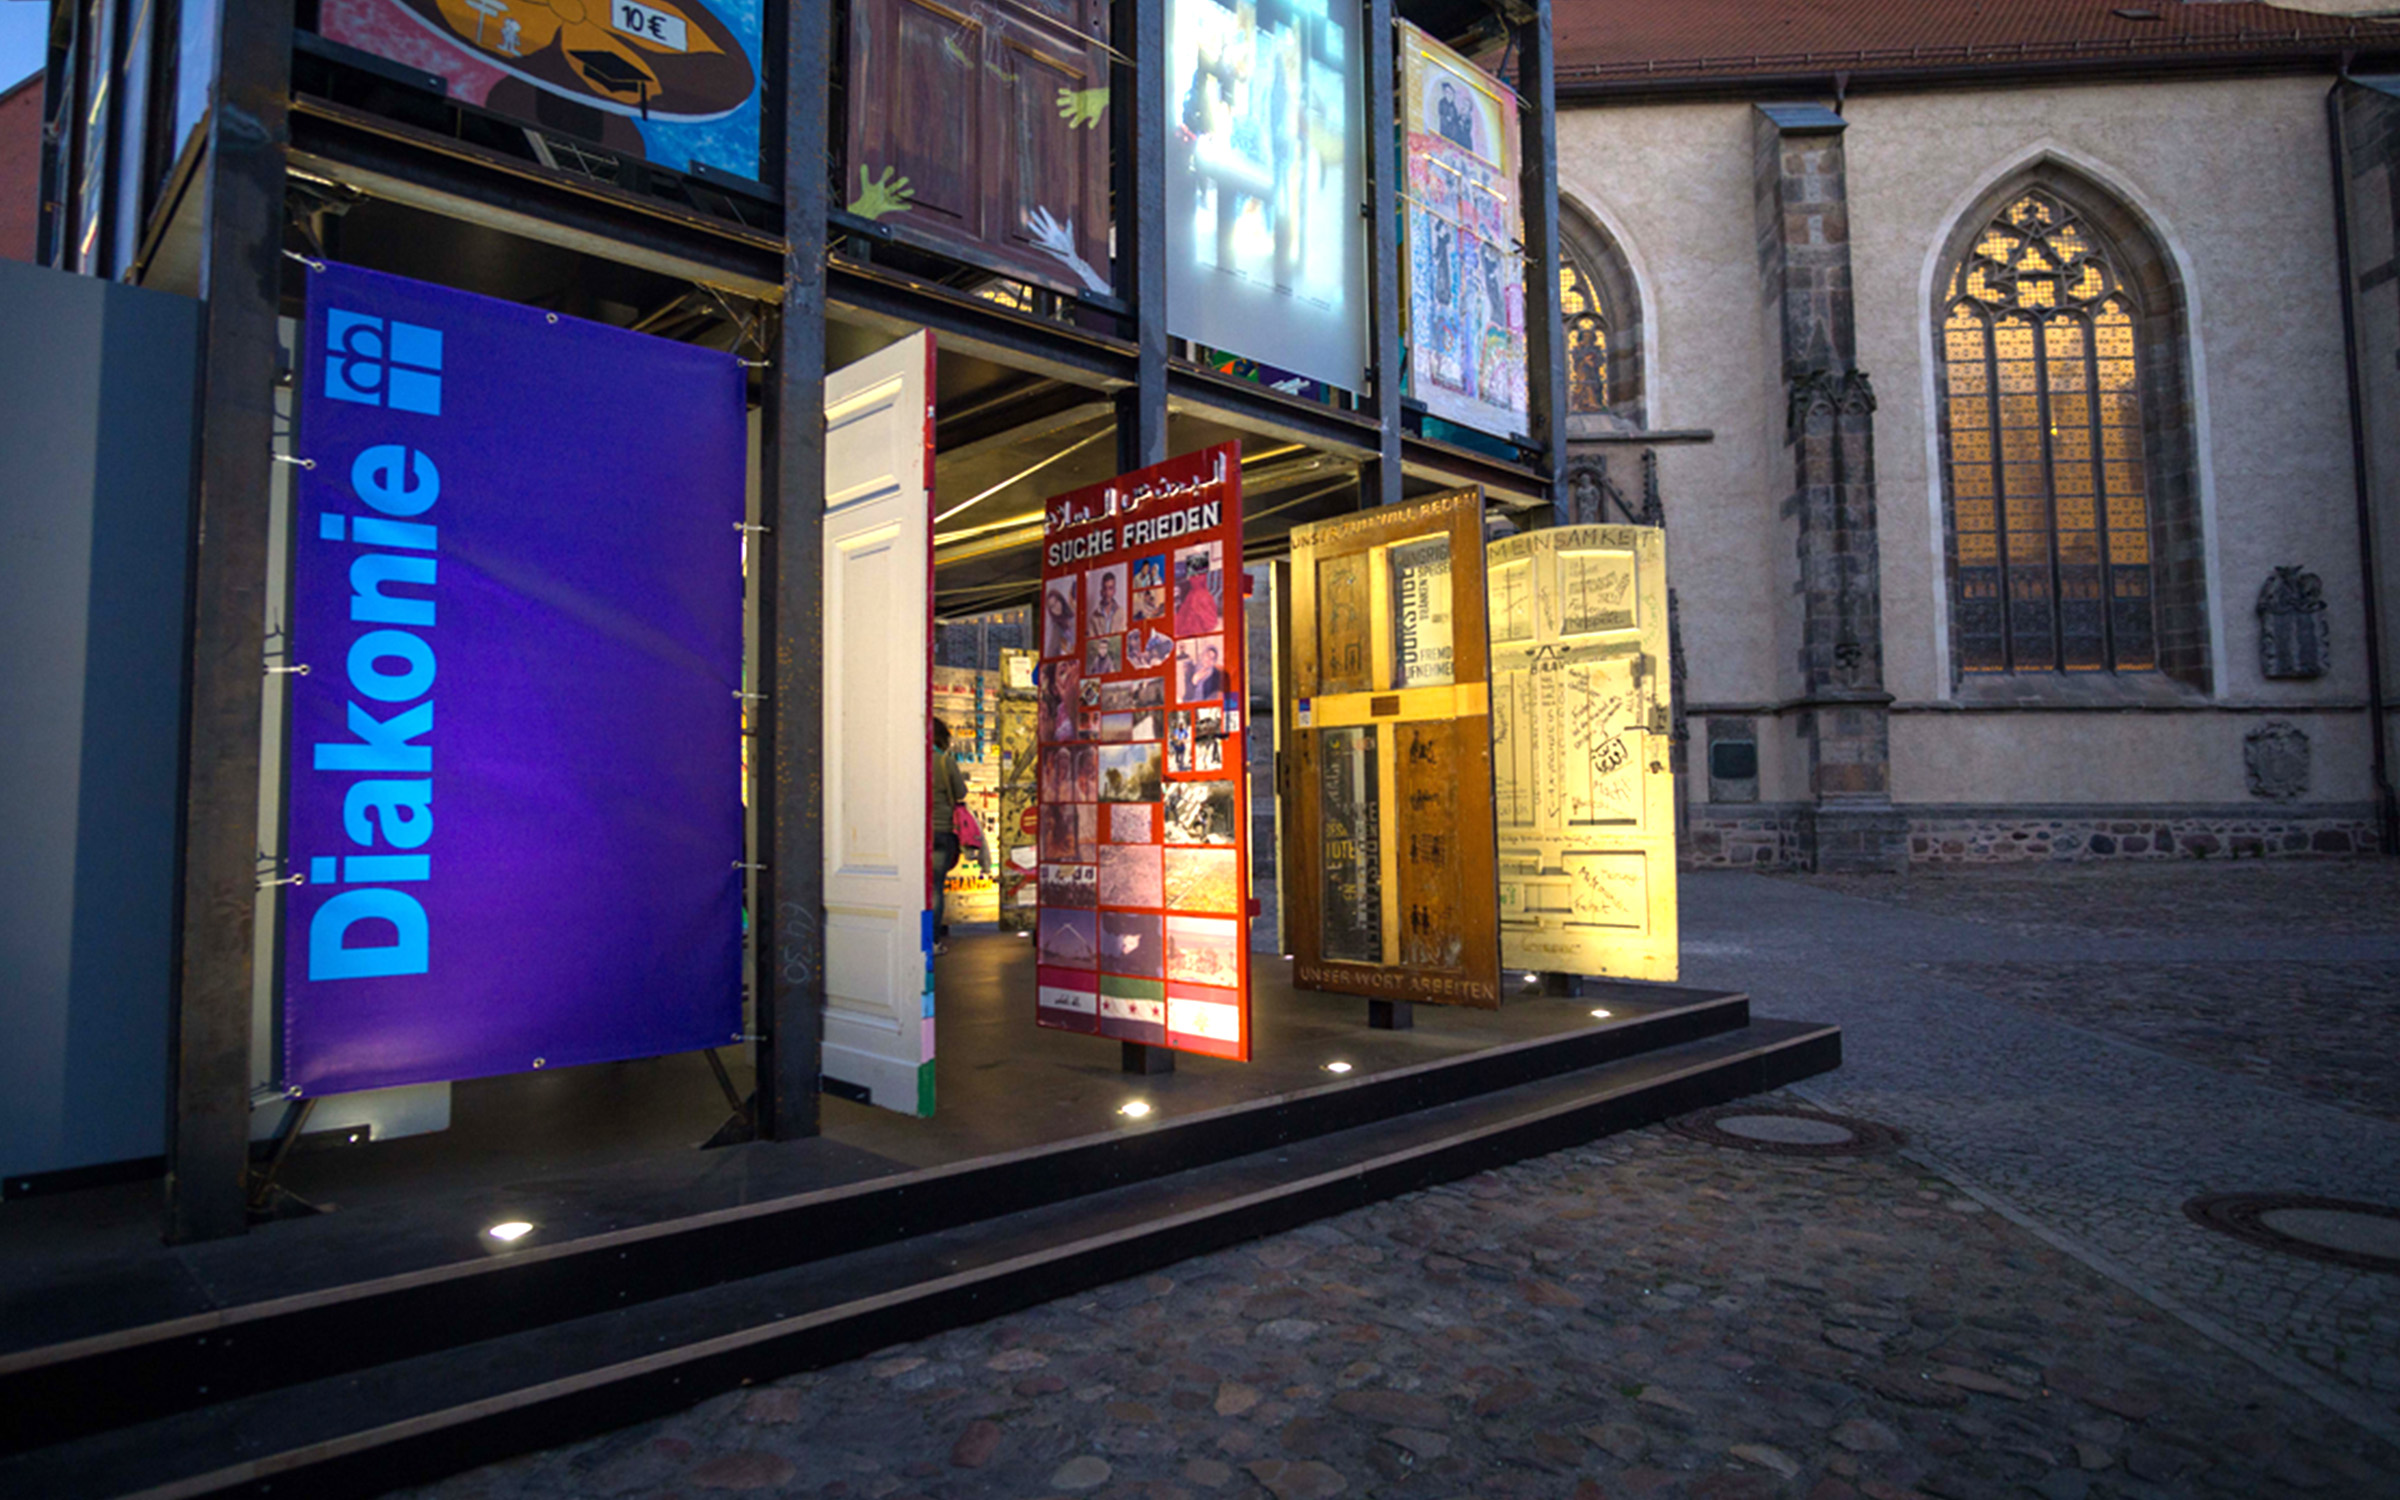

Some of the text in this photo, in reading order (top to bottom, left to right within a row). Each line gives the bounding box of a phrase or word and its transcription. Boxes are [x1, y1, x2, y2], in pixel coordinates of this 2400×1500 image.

[1048, 501, 1221, 567] SUCHE FRIEDEN
[307, 444, 441, 981] Diakonie
[1299, 965, 1495, 1000] UNSER WORT ARBEITEN
